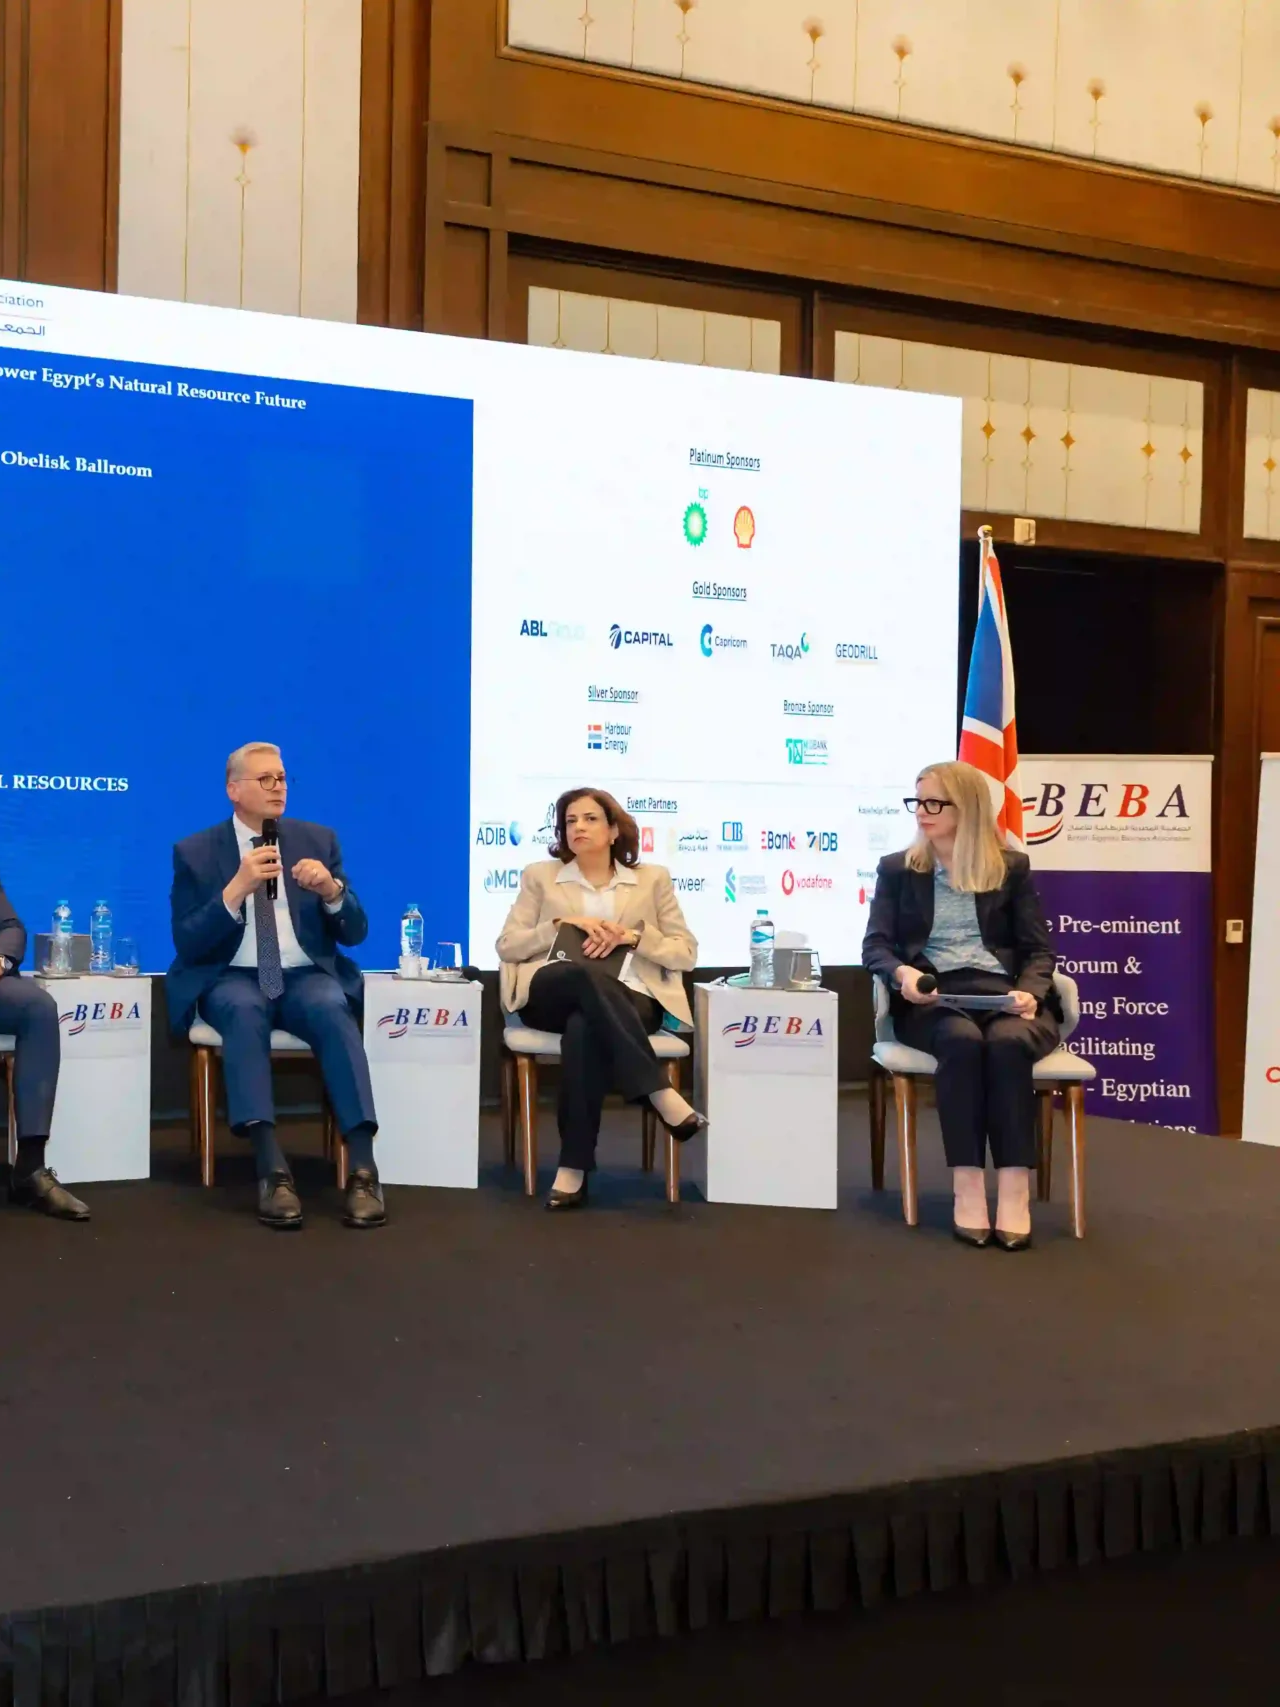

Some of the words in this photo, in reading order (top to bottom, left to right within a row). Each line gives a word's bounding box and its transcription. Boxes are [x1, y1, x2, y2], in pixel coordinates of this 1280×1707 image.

[109, 375, 172, 396] Natural
[177, 383, 251, 404] Resource
[254, 391, 307, 410] Future
[1, 451, 70, 470] Obelisk
[76, 457, 152, 478] Ballroom
[689, 448, 724, 465] Platinum
[726, 452, 761, 469] Sponsors
[698, 486, 709, 500] bp
[692, 581, 710, 596] Gold
[713, 583, 747, 599] Sponsors
[520, 619, 547, 637] ABL
[624, 631, 674, 646] CAPITAL
[714, 635, 748, 649] Capricorn
[770, 644, 802, 660] TAQA
[835, 643, 878, 660] GEODRILL
[588, 685, 608, 699] Silver
[610, 687, 638, 702] Sponsor
[783, 700, 806, 712] Bronze
[807, 701, 834, 715] Sponsor
[604, 721, 632, 736] Harbour
[604, 736, 628, 754] Energy
[13, 774, 129, 792] RESOURCES
[627, 797, 646, 809] Event
[648, 797, 678, 810] Partners
[1035, 783, 1190, 818] BEBA
[476, 827, 506, 845] ADIB
[722, 821, 743, 842] CIB
[495, 870, 524, 888] MC
[796, 874, 833, 889] vodafone
[1059, 915, 1181, 934] Pre-eminent
[1055, 955, 1118, 974] Forum
[1124, 956, 1143, 974] &
[73, 1002, 140, 1021] BEBA
[1113, 997, 1169, 1015] Force
[395, 1008, 468, 1026] BEBA
[741, 1016, 823, 1035] BEBA
[1059, 1037, 1155, 1060] acilitating
[1101, 1078, 1191, 1101] Egyptian
